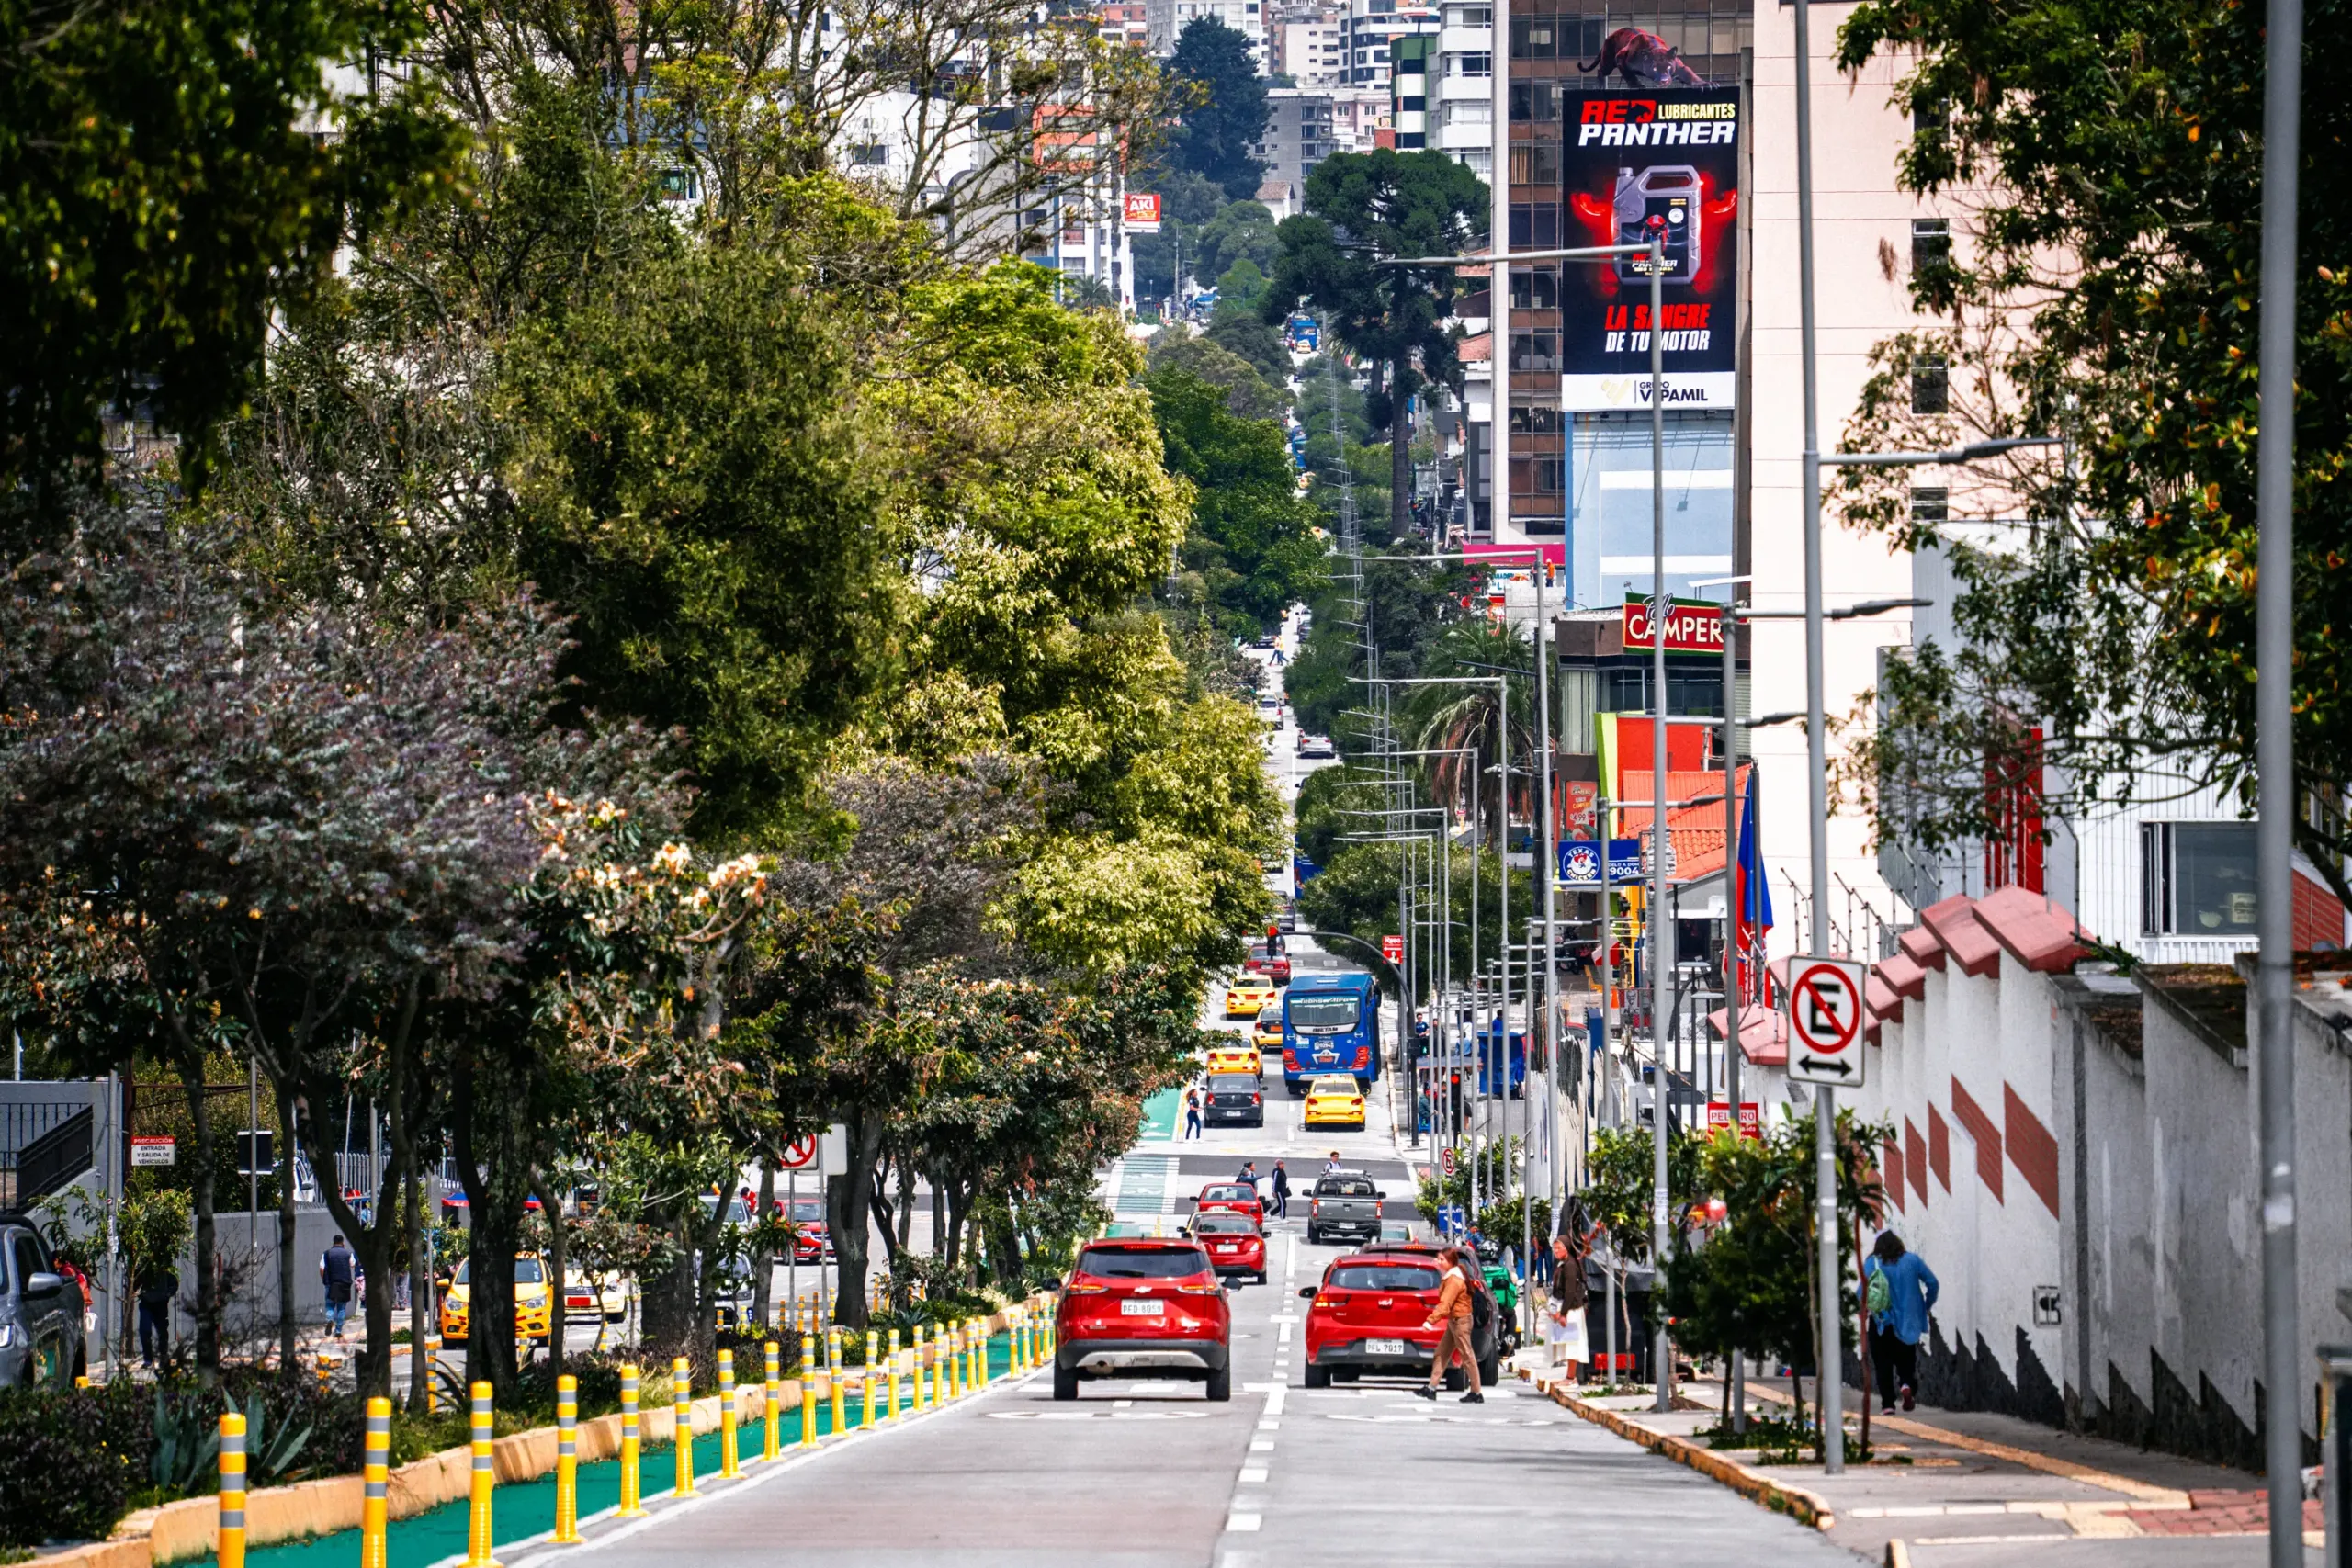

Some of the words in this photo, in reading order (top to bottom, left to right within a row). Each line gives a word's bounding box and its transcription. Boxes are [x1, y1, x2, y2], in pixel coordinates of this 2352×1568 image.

[1657, 103, 1736, 120] LUBRICANTES
[1578, 121, 1736, 146] PANTHER
[1129, 199, 1154, 211] AKI
[1604, 304, 1628, 330] LA
[1605, 331, 1626, 352] DE
[1630, 331, 1651, 352] TU
[1640, 389, 1708, 402] VPAMIL
[1628, 615, 1724, 643] CAMPER
[1568, 848, 1594, 858] TEXAS
[1711, 1112, 1755, 1121] PELRO
